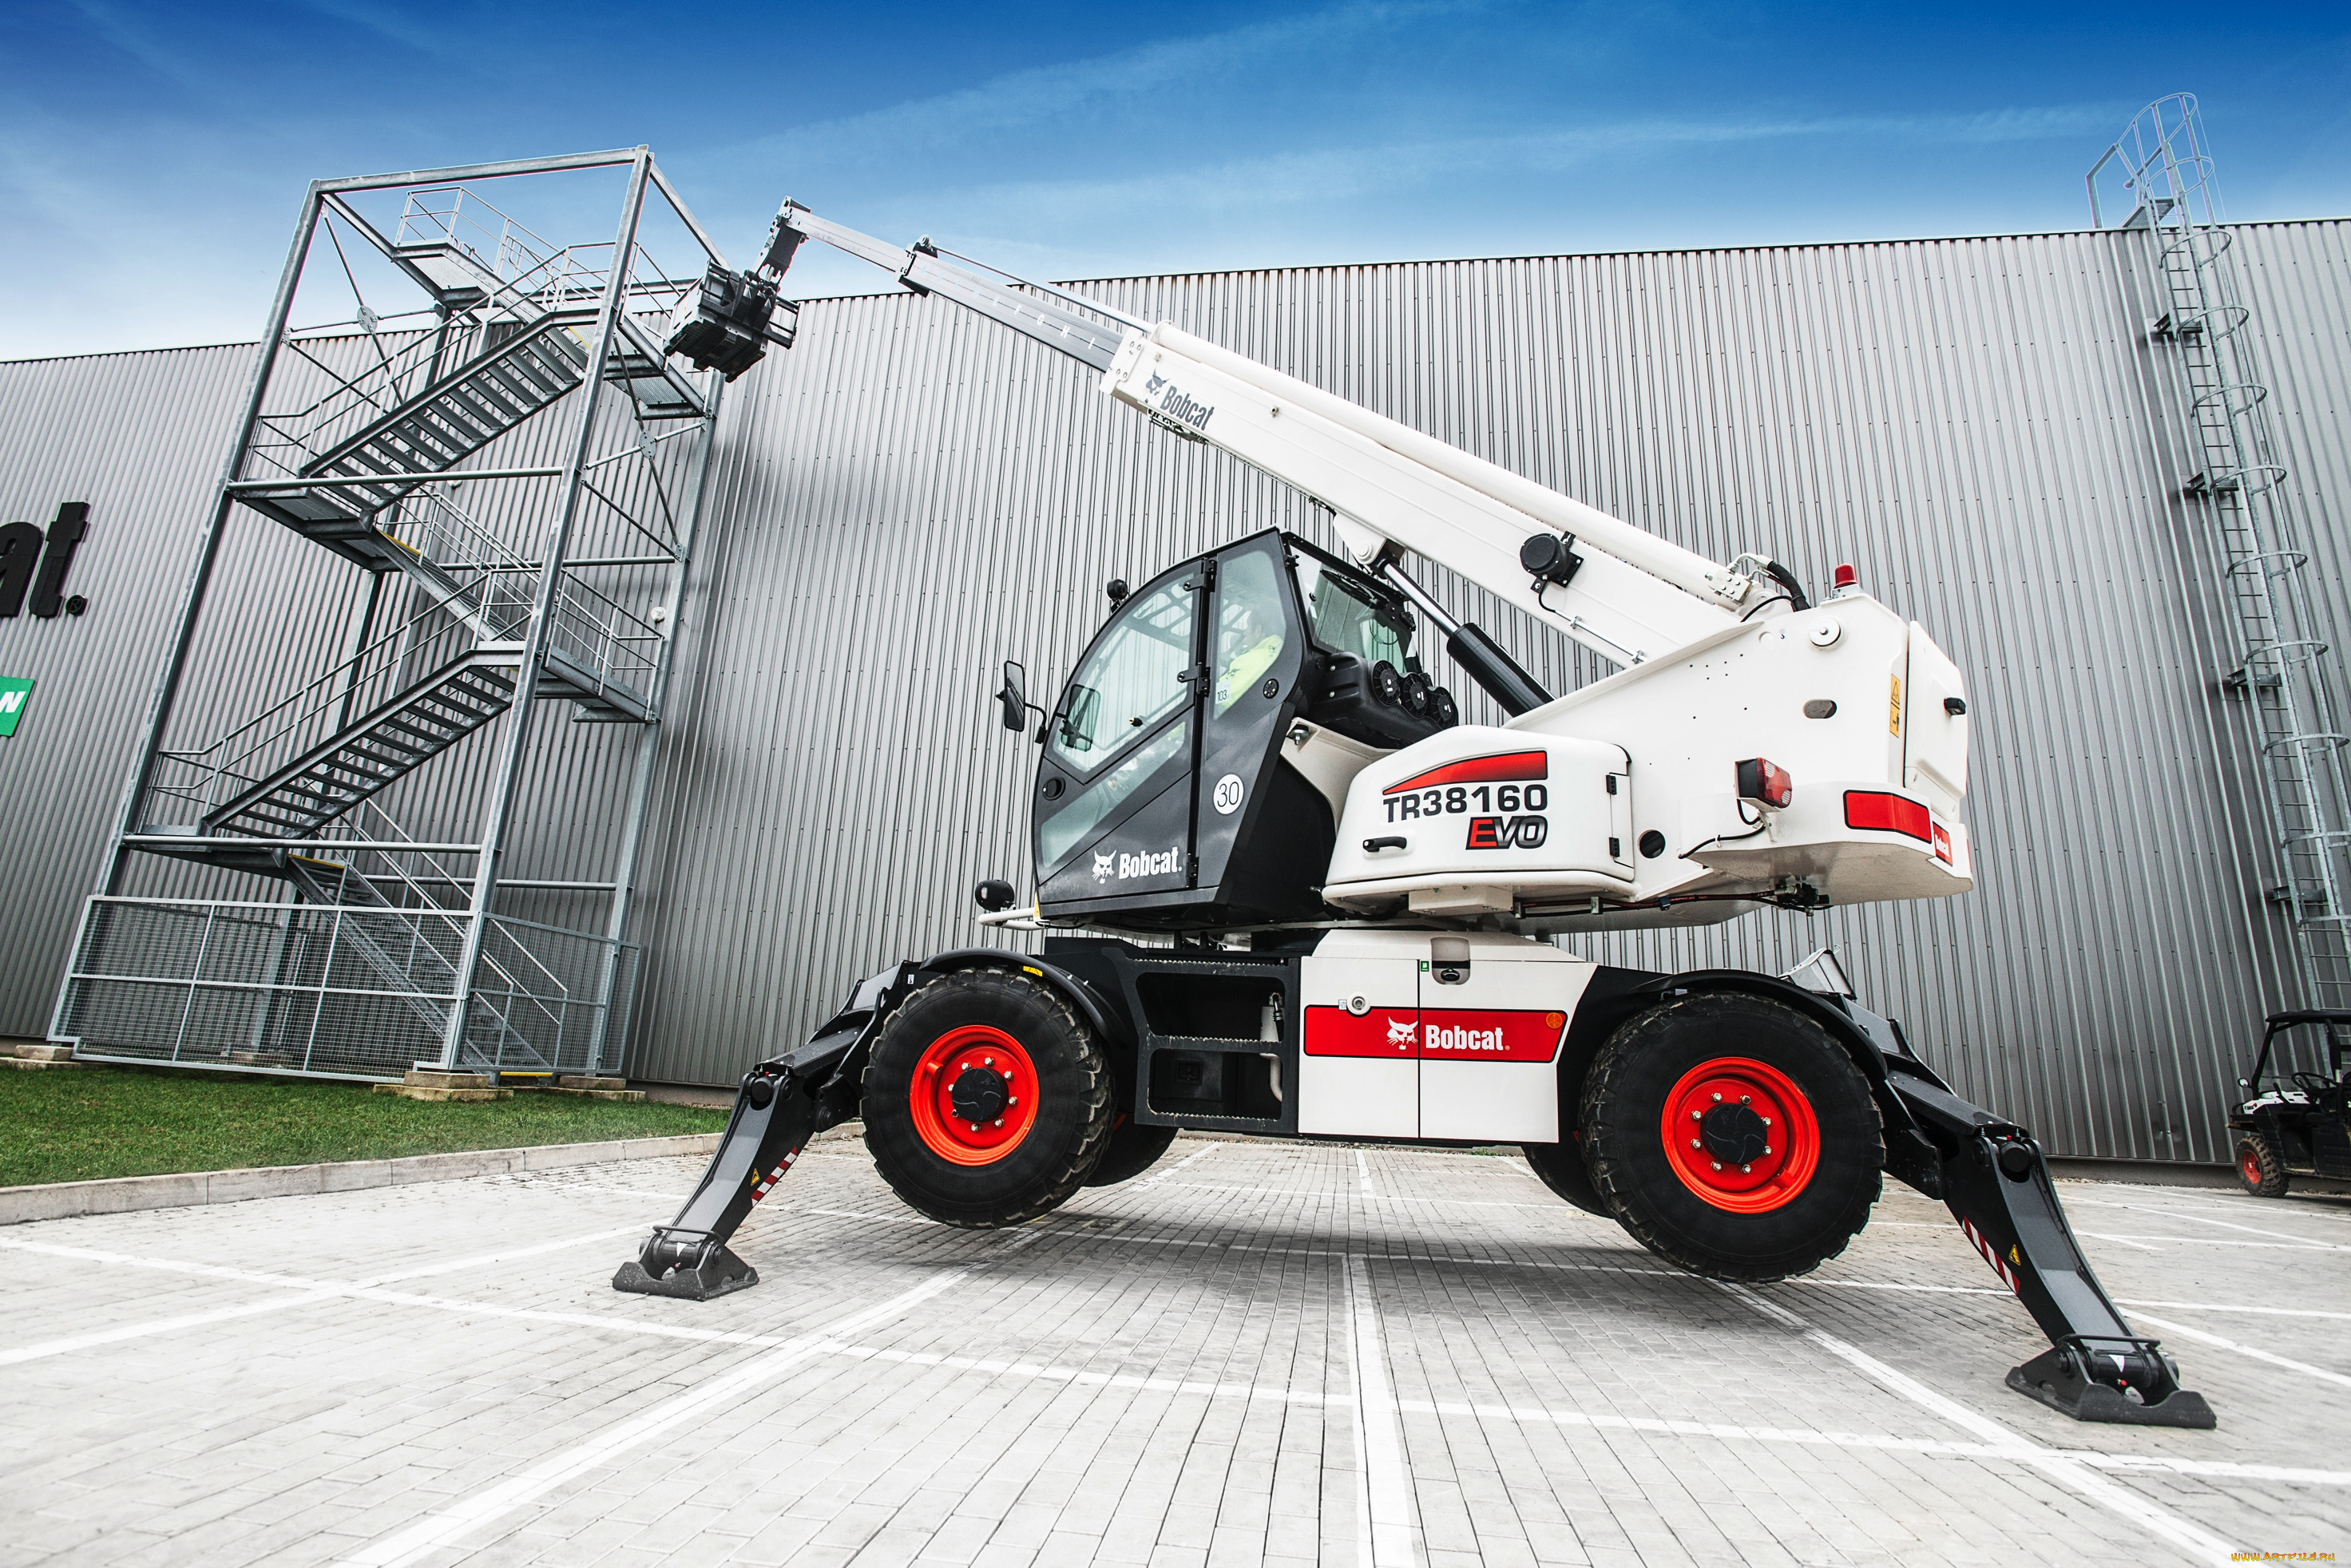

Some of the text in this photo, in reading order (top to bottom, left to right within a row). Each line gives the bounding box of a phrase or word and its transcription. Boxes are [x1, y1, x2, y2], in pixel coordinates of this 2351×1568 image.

[1037, 314, 1045, 326] G
[1061, 325, 1070, 338] H
[1160, 385, 1215, 431] Bobcat
[1217, 689, 1227, 702] 103
[1217, 781, 1239, 808] 30
[1383, 784, 1548, 823] TR38160
[1465, 815, 1548, 849] EVO
[1119, 846, 1179, 880] Bobcat
[1425, 1024, 1505, 1051] Bobcat
